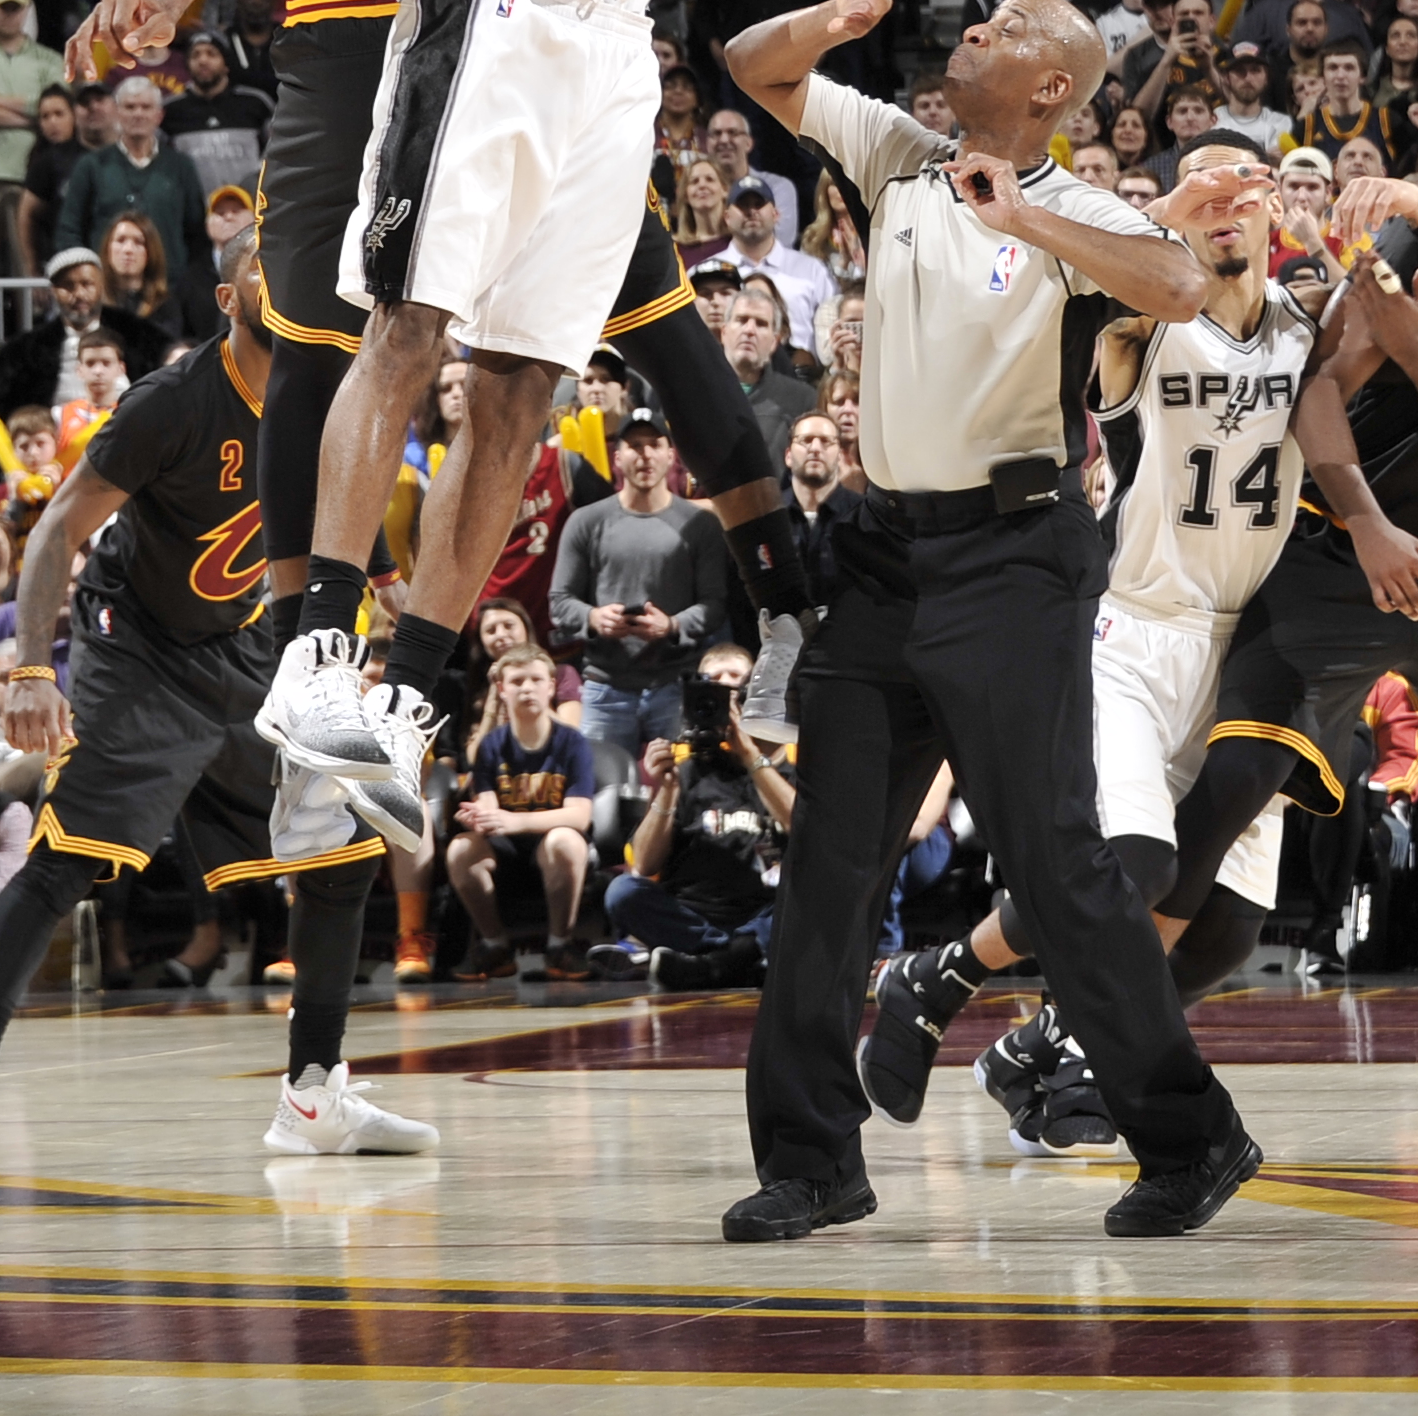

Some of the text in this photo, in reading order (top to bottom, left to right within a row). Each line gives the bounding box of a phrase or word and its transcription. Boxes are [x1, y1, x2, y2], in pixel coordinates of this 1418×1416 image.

[1158, 372, 1295, 419] SPUR
[221, 439, 244, 492] 2
[1180, 445, 1280, 531] 14
[527, 521, 550, 556] 2
[496, 771, 567, 807] CAVS
[723, 810, 763, 836] NBA
